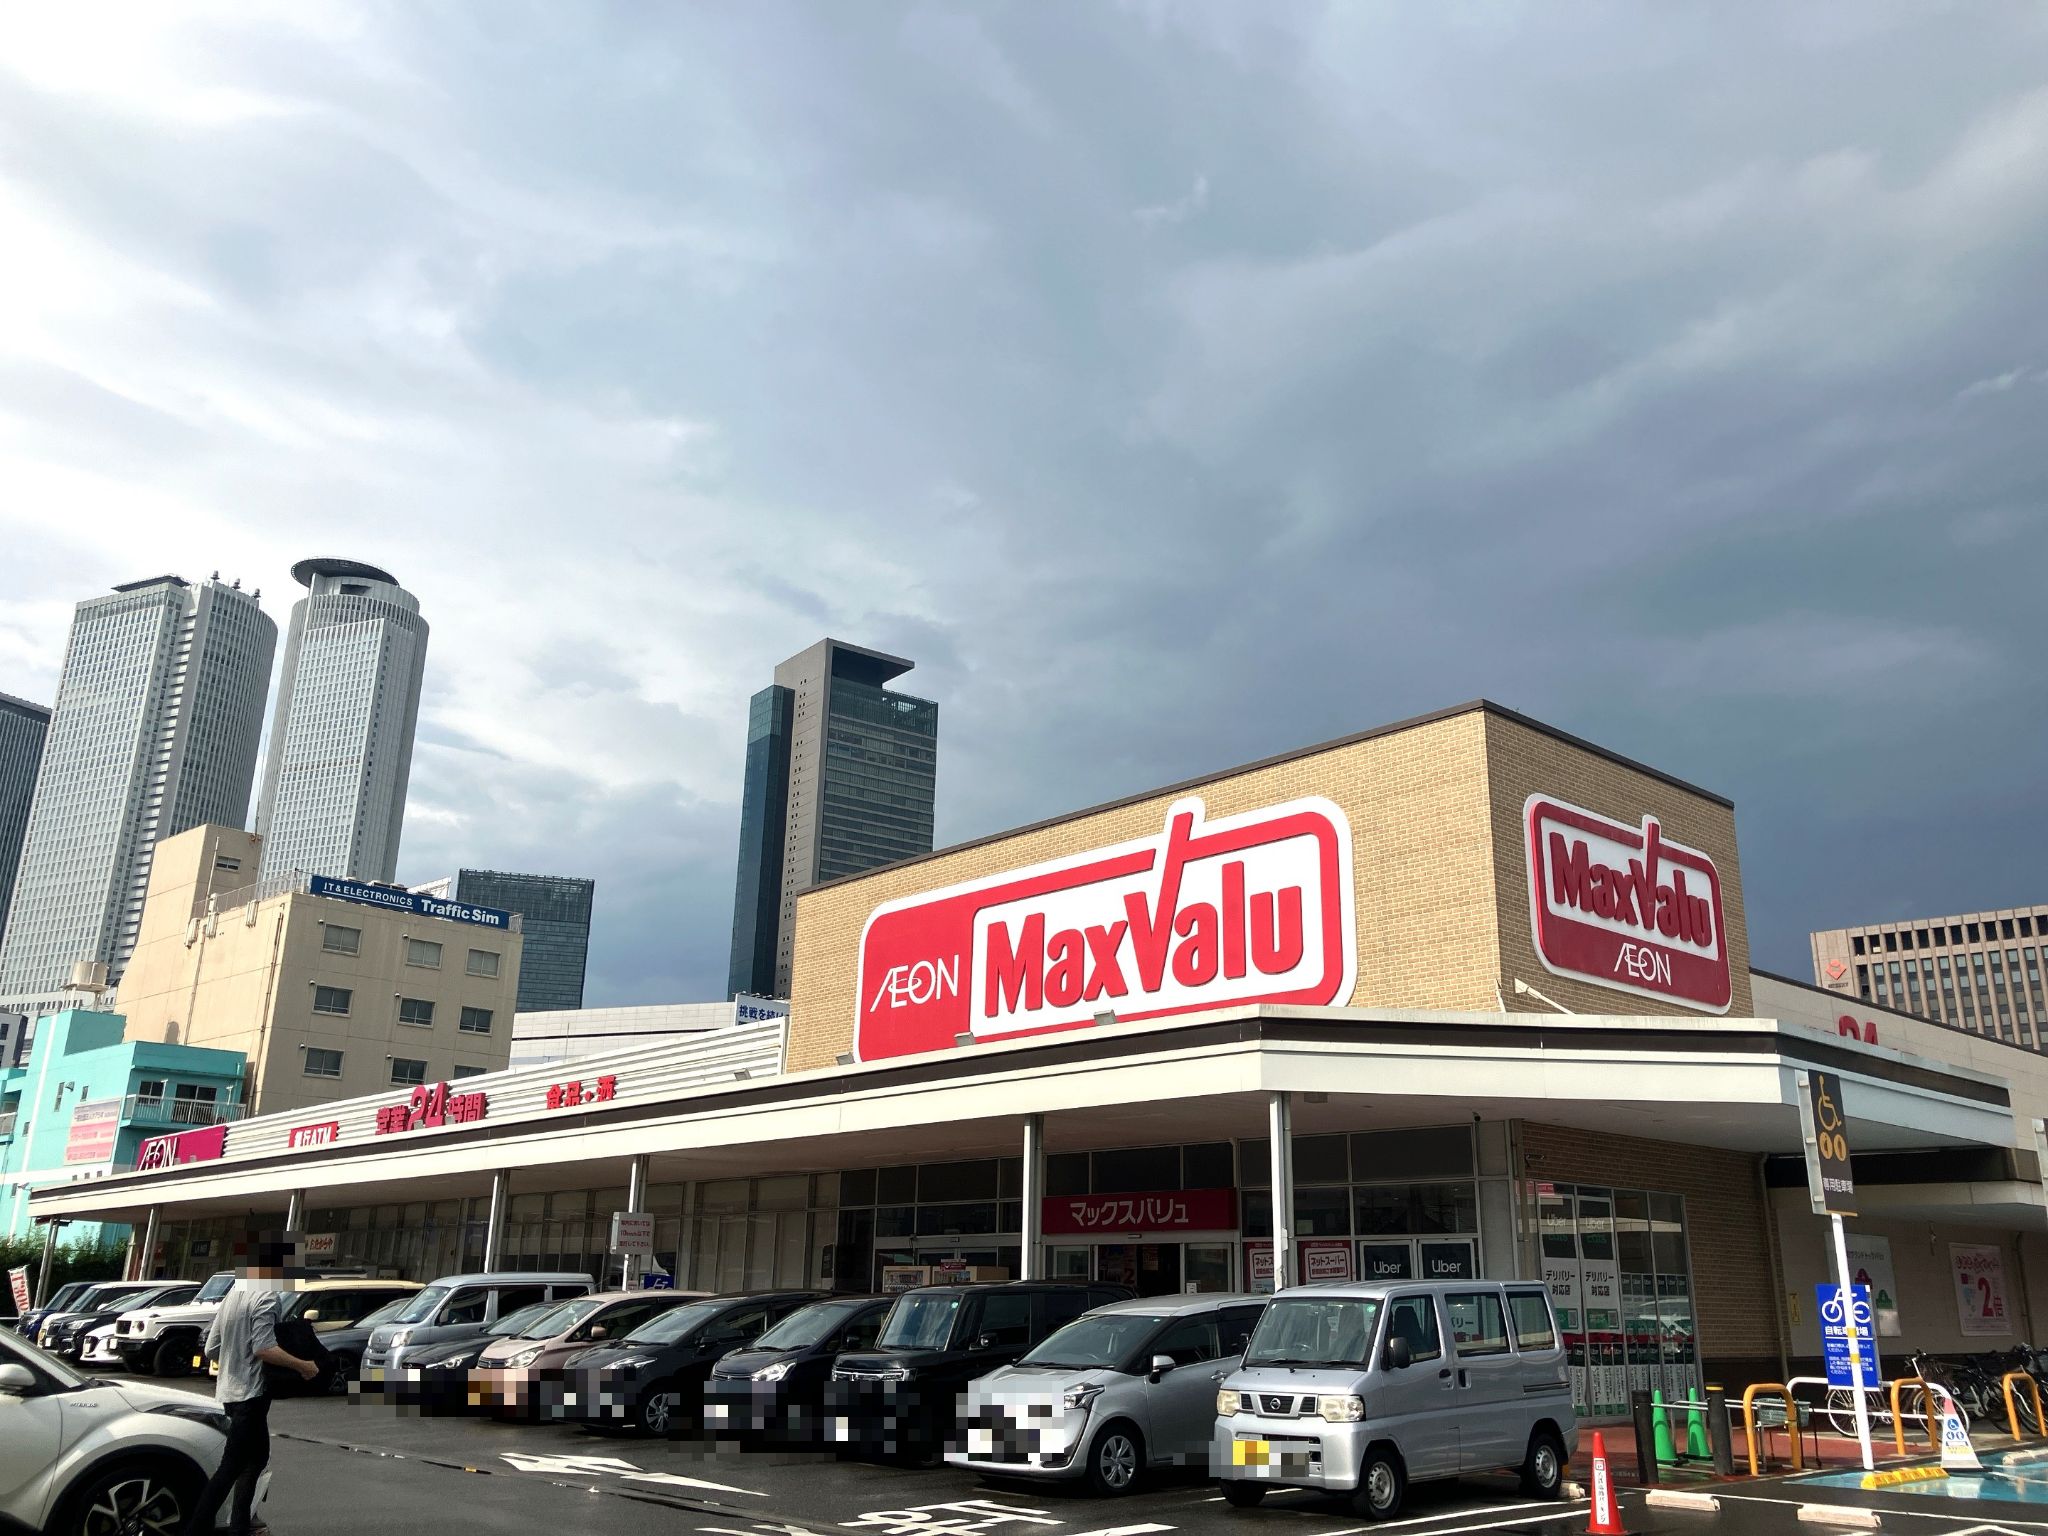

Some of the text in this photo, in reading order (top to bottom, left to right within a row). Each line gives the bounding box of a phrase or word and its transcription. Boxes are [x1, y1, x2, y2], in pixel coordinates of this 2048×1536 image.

[1549, 823, 1713, 948] MaxValu
[421, 899, 470, 919] Traffic
[985, 812, 1304, 1018] MaxValu
[1070, 1198, 1189, 1227] マックスバリュ
[1373, 1260, 1401, 1274] Uber
[1431, 1259, 1461, 1273] Uber
[1545, 1269, 1576, 1281] デリバリー
[1585, 1271, 1615, 1283] デリバリー
